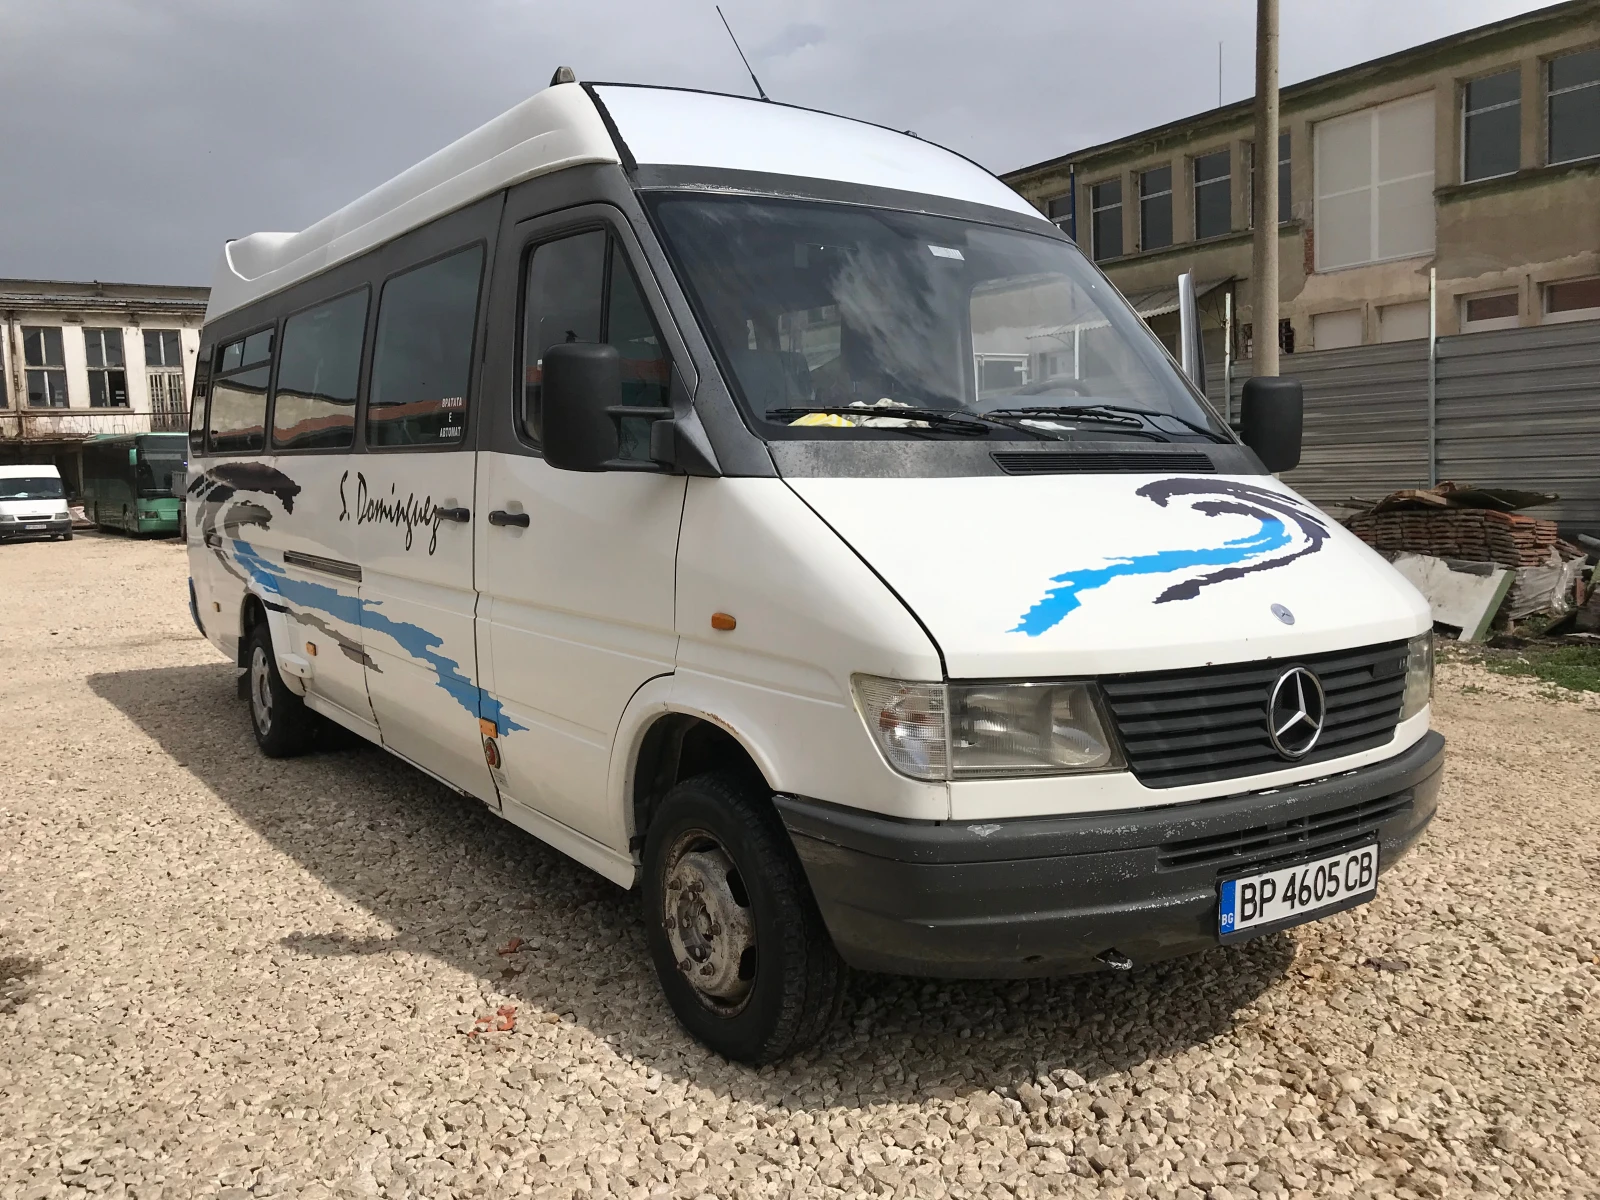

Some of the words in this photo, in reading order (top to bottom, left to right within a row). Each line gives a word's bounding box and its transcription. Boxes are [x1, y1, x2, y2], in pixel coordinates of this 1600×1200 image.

[442, 397, 462, 407] ВРАТАТА
[440, 426, 461, 437] АВТОМАТ
[339, 470, 350, 521] S.
[357, 472, 440, 555] Dominguez
[1240, 878, 1276, 922] BP
[1281, 860, 1341, 909] 4605
[1344, 851, 1373, 892] CB
[1221, 913, 1234, 926] BG
